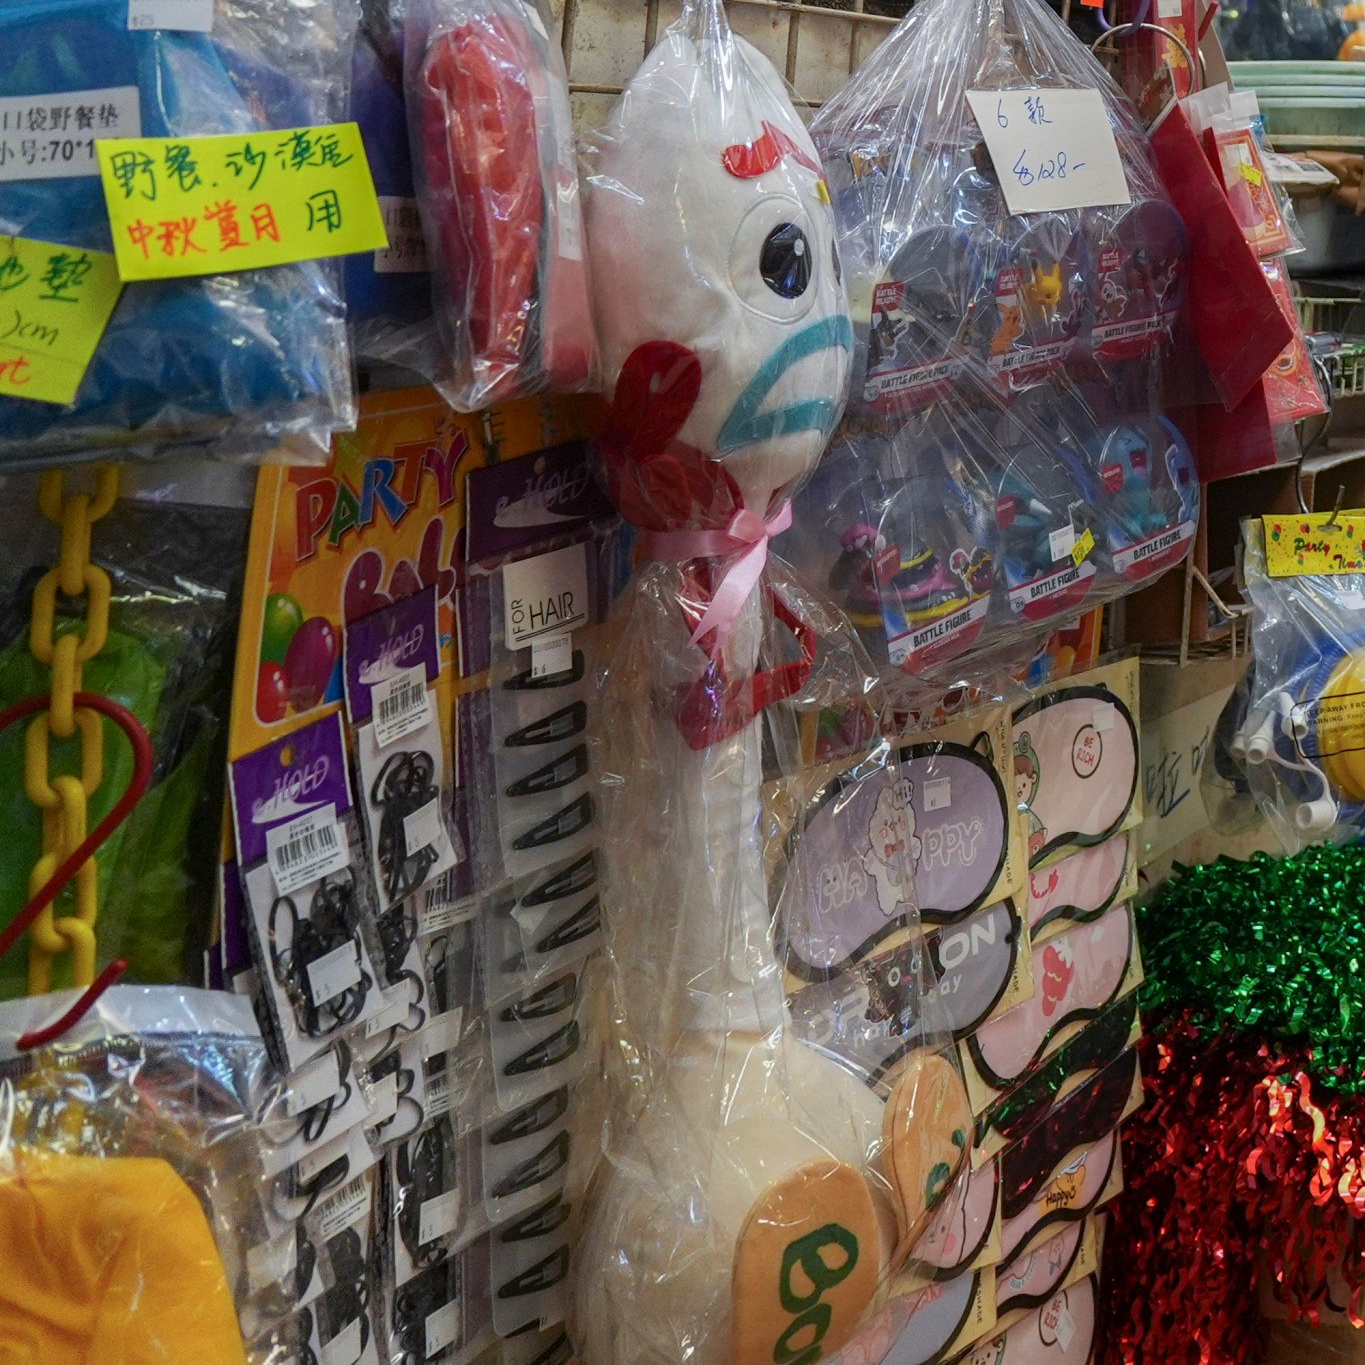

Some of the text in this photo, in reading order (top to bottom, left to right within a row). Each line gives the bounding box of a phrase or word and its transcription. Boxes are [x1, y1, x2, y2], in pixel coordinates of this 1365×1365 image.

[996, 98, 1009, 129] 6
[296, 429, 470, 562] PARTY
[1134, 530, 1182, 560] BATTLE FIGURE
[1030, 568, 1080, 599] BATTLE FIGURE
[511, 590, 575, 635] FOR HAIR
[913, 609, 973, 648] BATTLE FIGURE
[1075, 748, 1097, 767] RICH
[1082, 736, 1096, 751] BE
